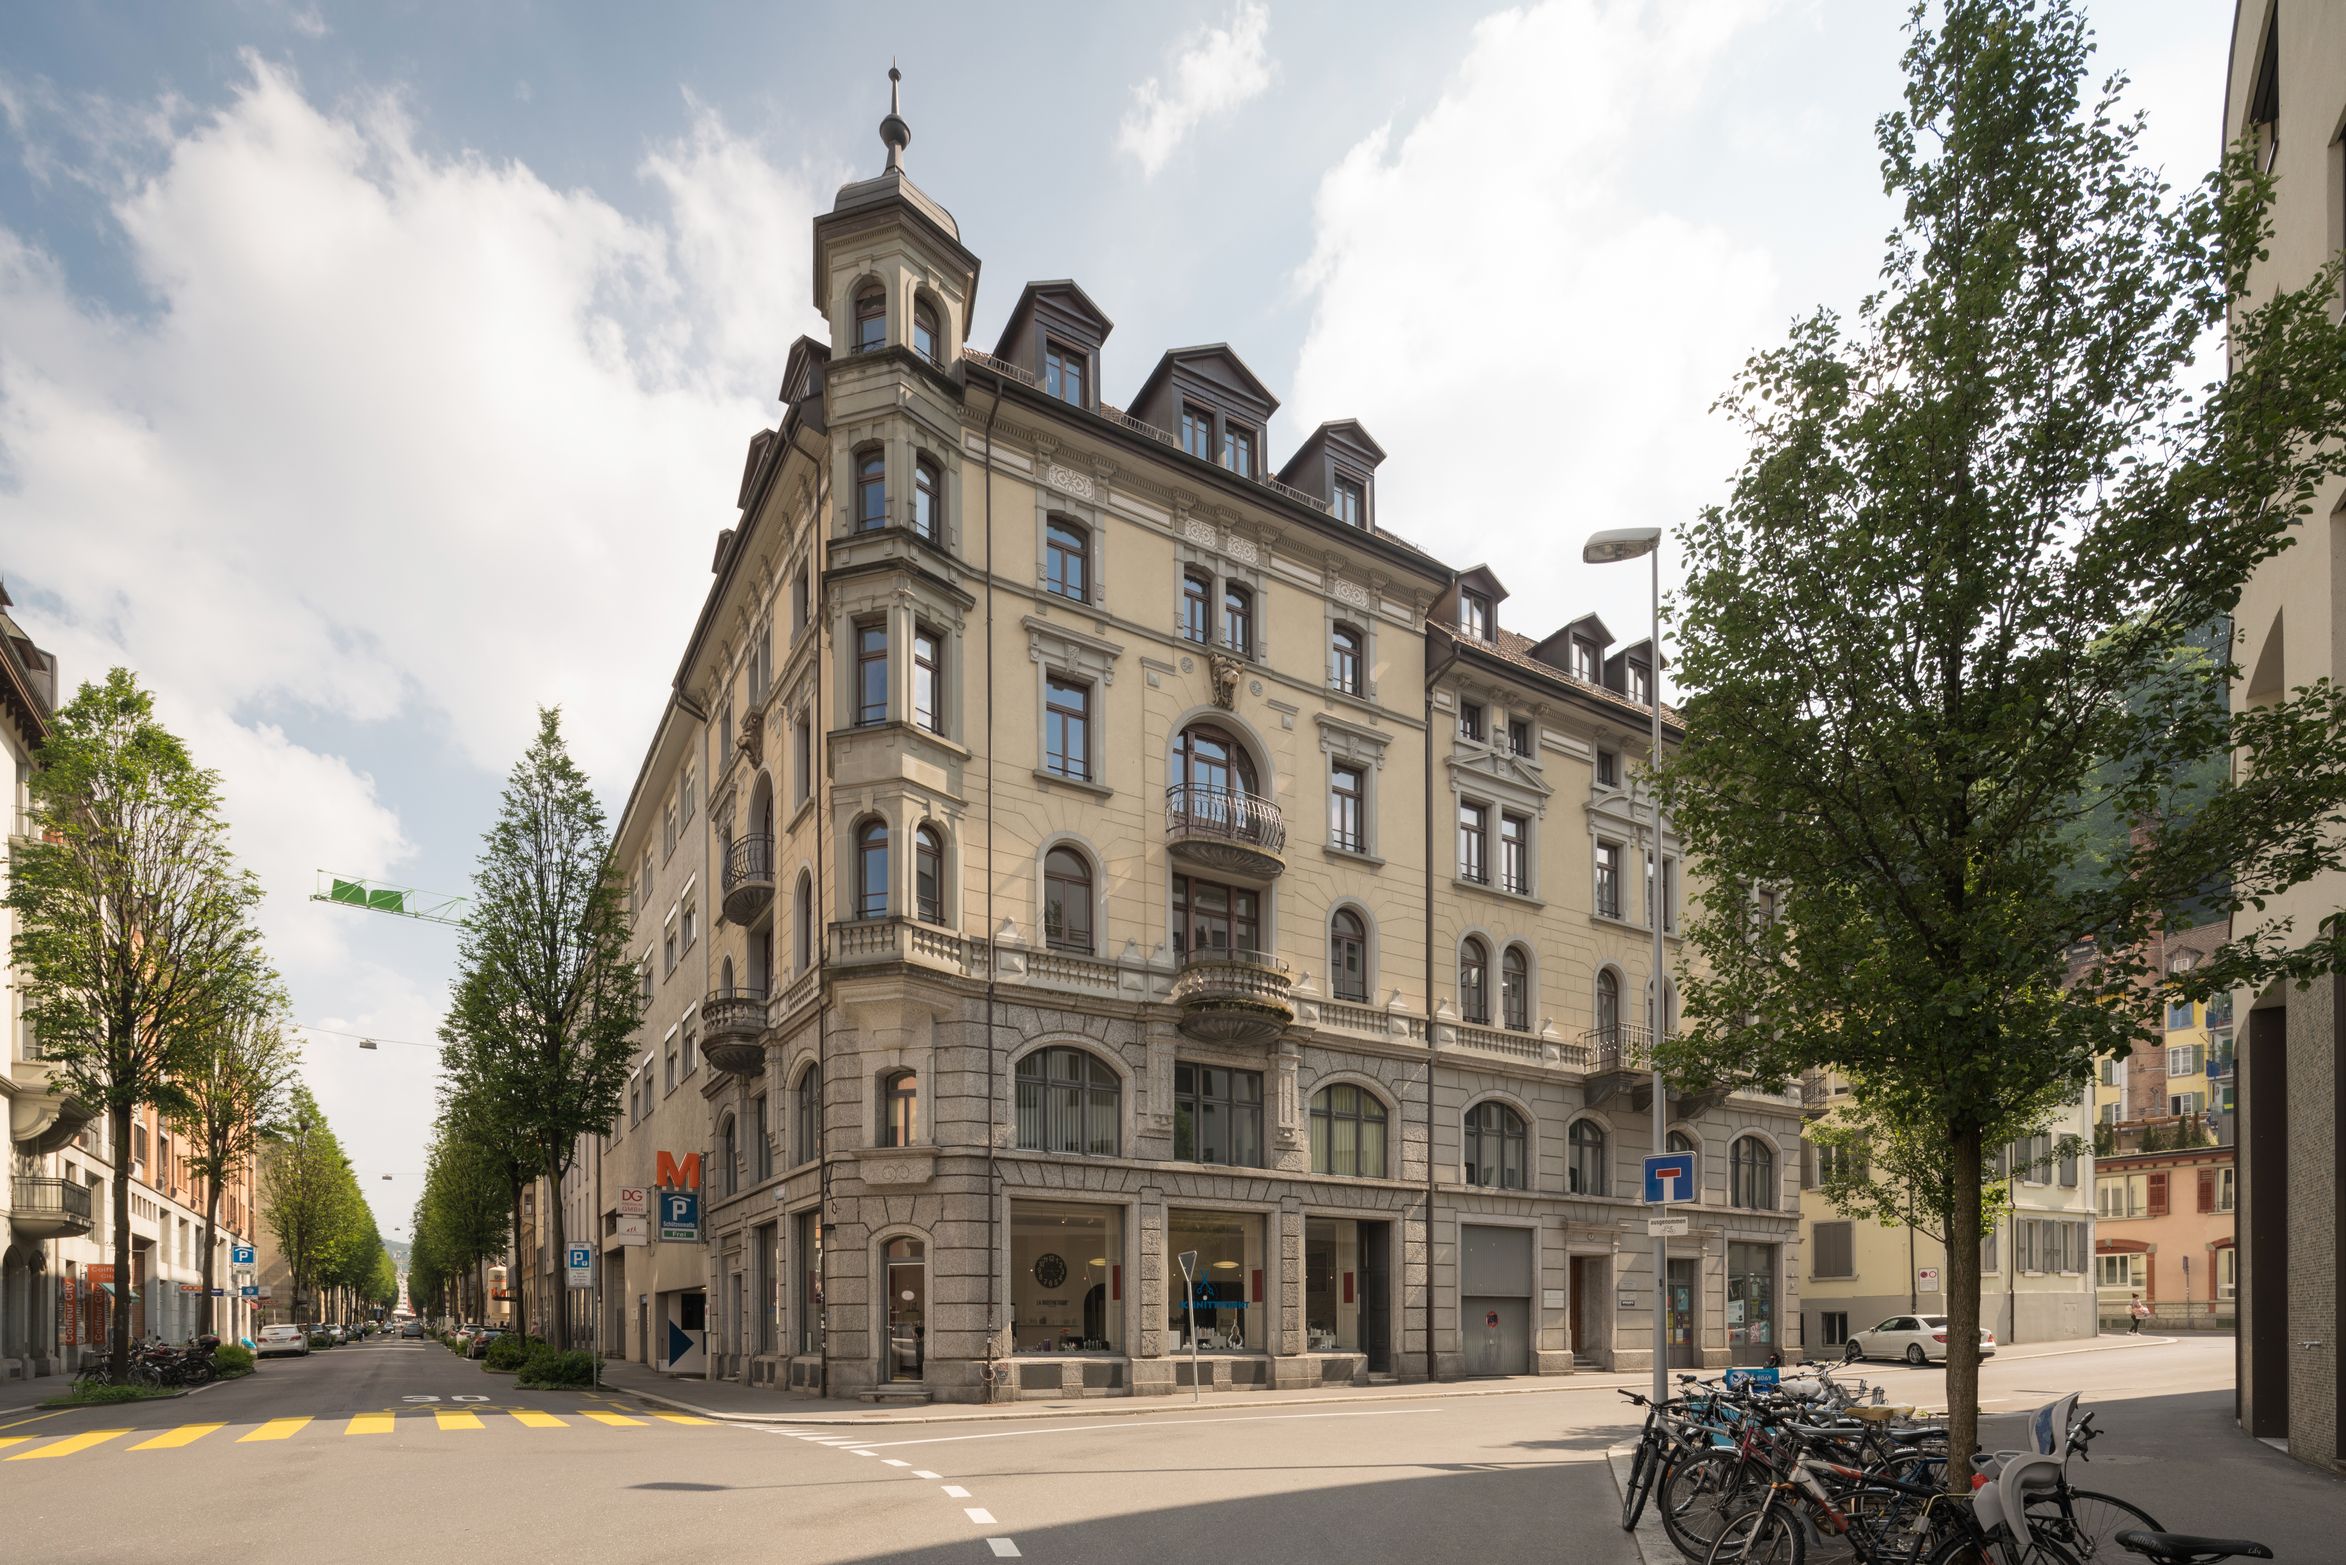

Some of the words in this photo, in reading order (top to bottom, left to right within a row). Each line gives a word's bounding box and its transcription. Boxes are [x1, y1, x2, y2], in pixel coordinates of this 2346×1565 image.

[656, 1151, 701, 1189] M
[622, 1189, 643, 1202] DG
[65, 1281, 75, 1300] City
[66, 1302, 74, 1343] Coiffeur
[401, 1395, 490, 1403] 30
